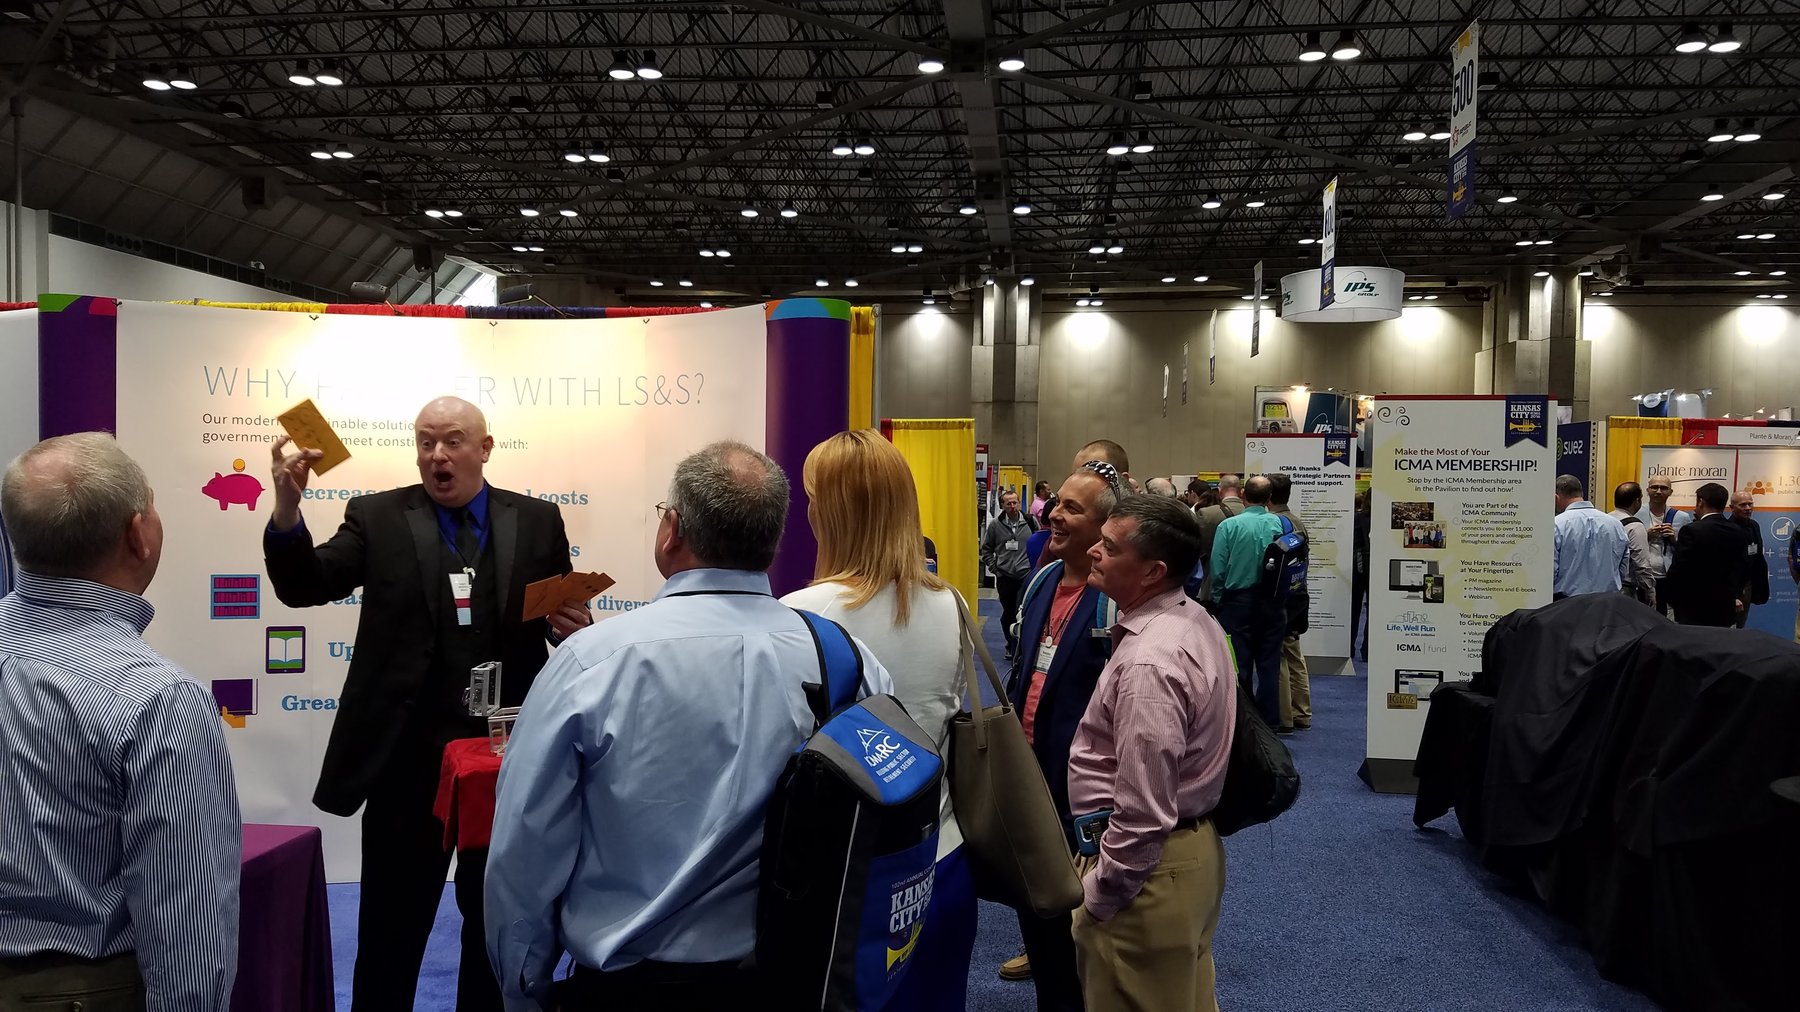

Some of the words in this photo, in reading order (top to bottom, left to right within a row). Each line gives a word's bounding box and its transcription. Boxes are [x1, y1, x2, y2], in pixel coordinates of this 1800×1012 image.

[1453, 59, 1474, 117] 500
[1343, 282, 1377, 292] IPS
[204, 365, 296, 398] WHY
[513, 377, 601, 406] WITH
[618, 372, 705, 406] LS&S?
[202, 413, 228, 424] Our
[328, 418, 368, 429] inable
[372, 419, 415, 430] solutio
[202, 432, 283, 444] governmen
[341, 437, 373, 446] meet
[376, 436, 415, 447] consti
[499, 438, 528, 449] with:
[1394, 448, 1418, 456] Make
[1420, 448, 1434, 456] the
[1436, 448, 1458, 456] Most
[1460, 448, 1469, 456] of
[1394, 459, 1433, 470] ICMA
[1436, 459, 1537, 471] MEMBERSHIP!
[1648, 464, 1685, 478] plante
[1689, 466, 1727, 477] moran
[302, 488, 386, 501] ecreas
[1387, 624, 1402, 632] Life,
[281, 695, 338, 711] Grea
[889, 897, 924, 933] CITY
